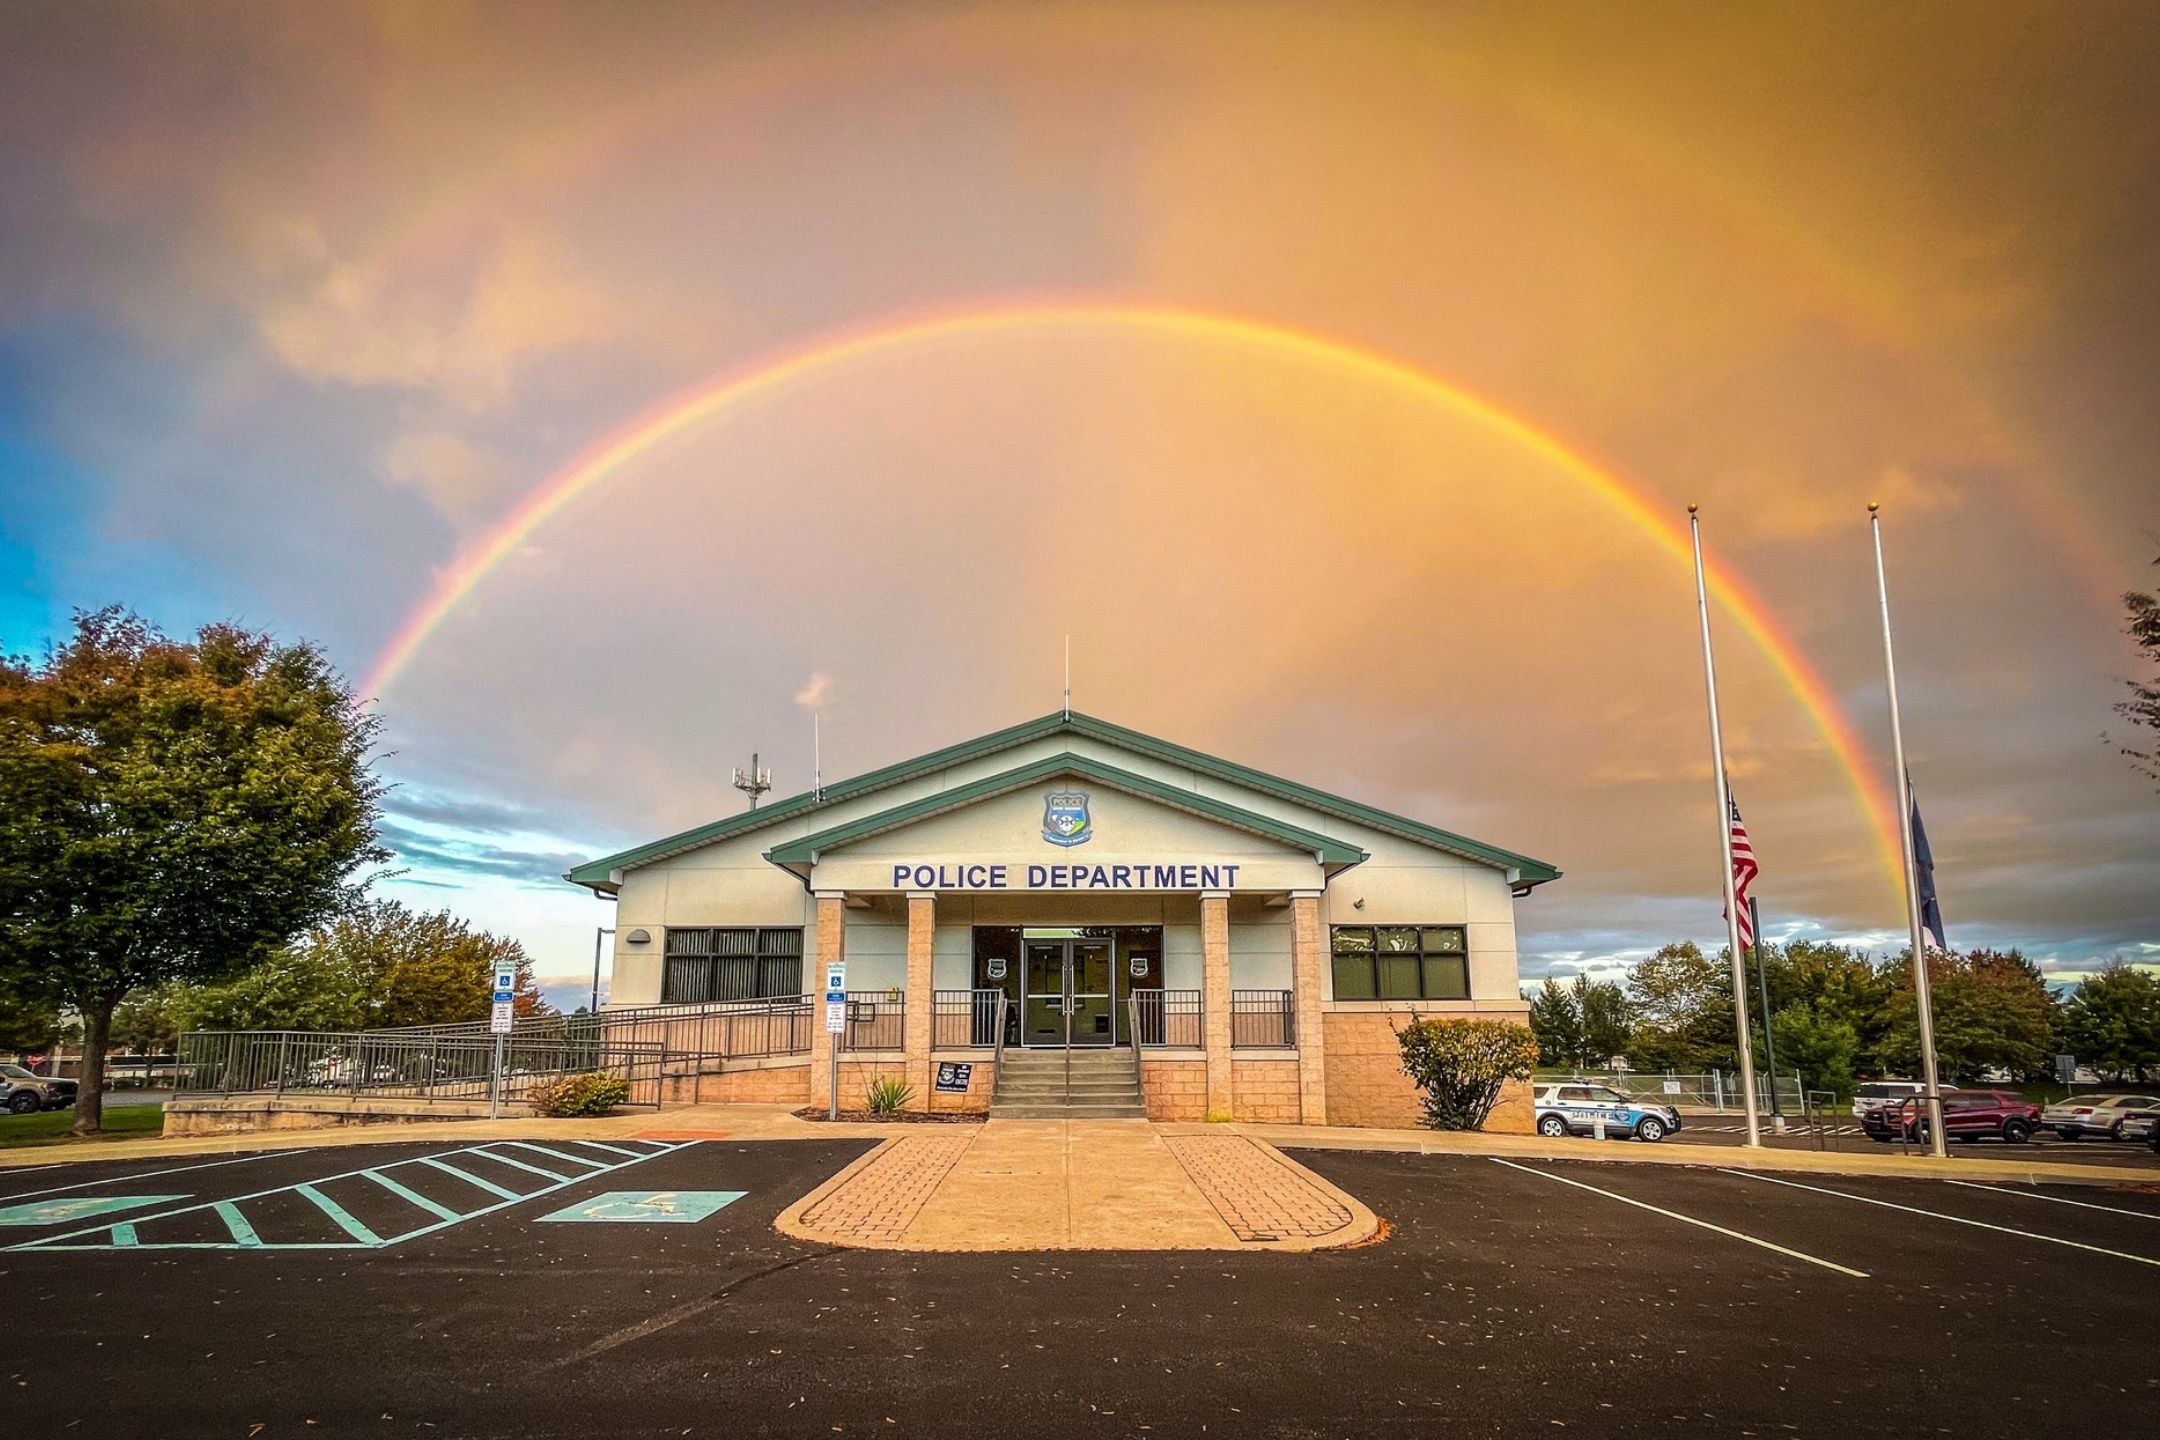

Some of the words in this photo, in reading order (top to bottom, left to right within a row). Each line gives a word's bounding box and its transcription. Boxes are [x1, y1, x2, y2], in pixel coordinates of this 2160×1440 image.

[1051, 798, 1082, 806] POLICE
[893, 865, 1007, 888] POLICE
[1028, 865, 1241, 888] DEPARTMENT
